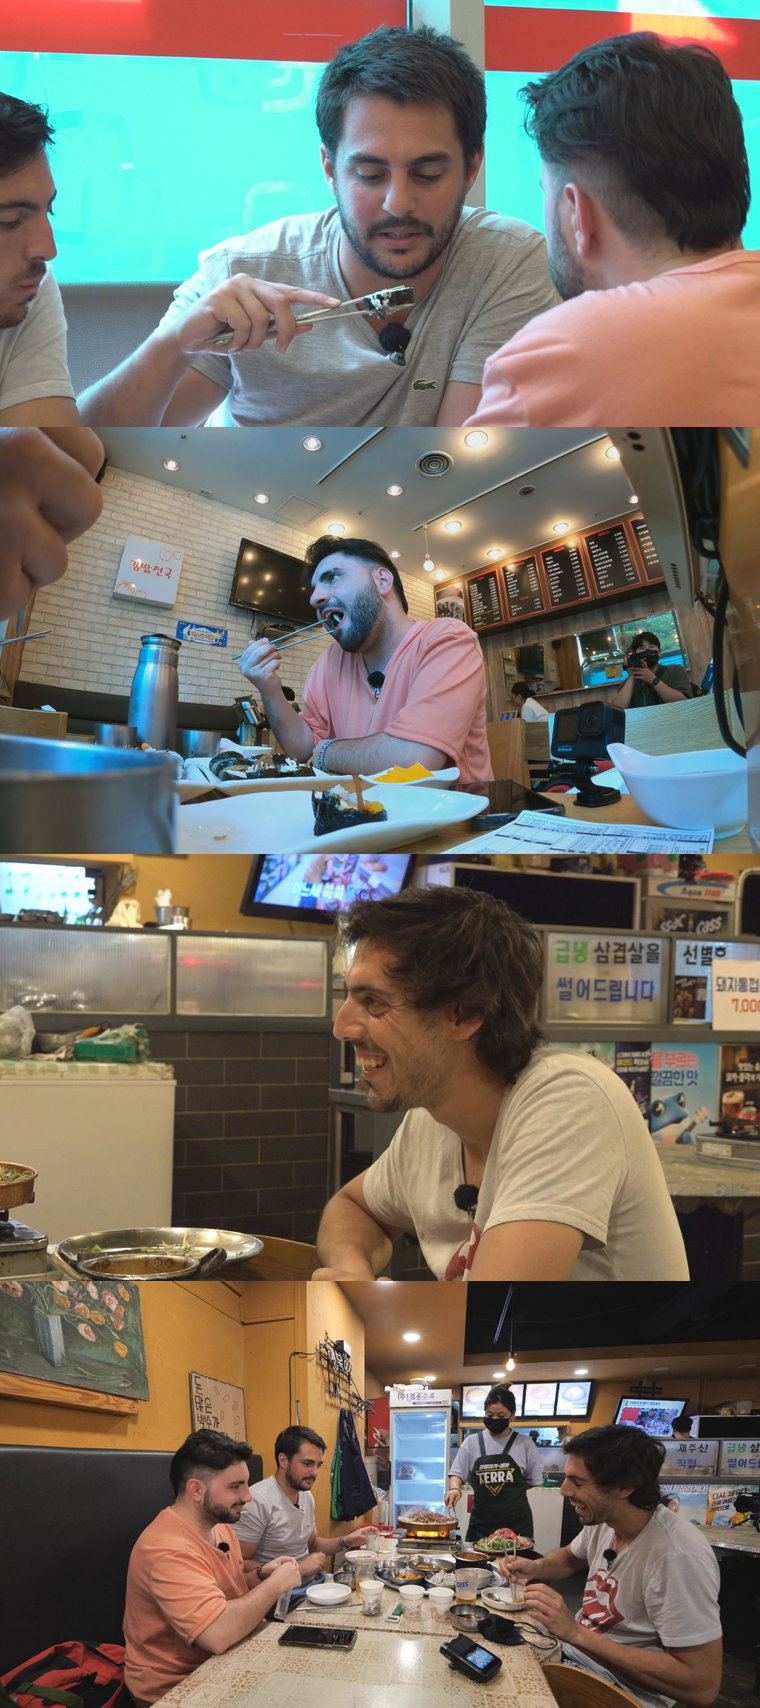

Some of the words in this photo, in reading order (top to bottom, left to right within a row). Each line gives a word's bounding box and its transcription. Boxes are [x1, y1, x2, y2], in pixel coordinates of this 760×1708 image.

[131, 559, 172, 580] 김밥천국
[555, 940, 588, 964] 급냉
[593, 942, 660, 964] 삼겹살을
[686, 1070, 698, 1086] 맛
[476, 1470, 514, 1484] TERRA
